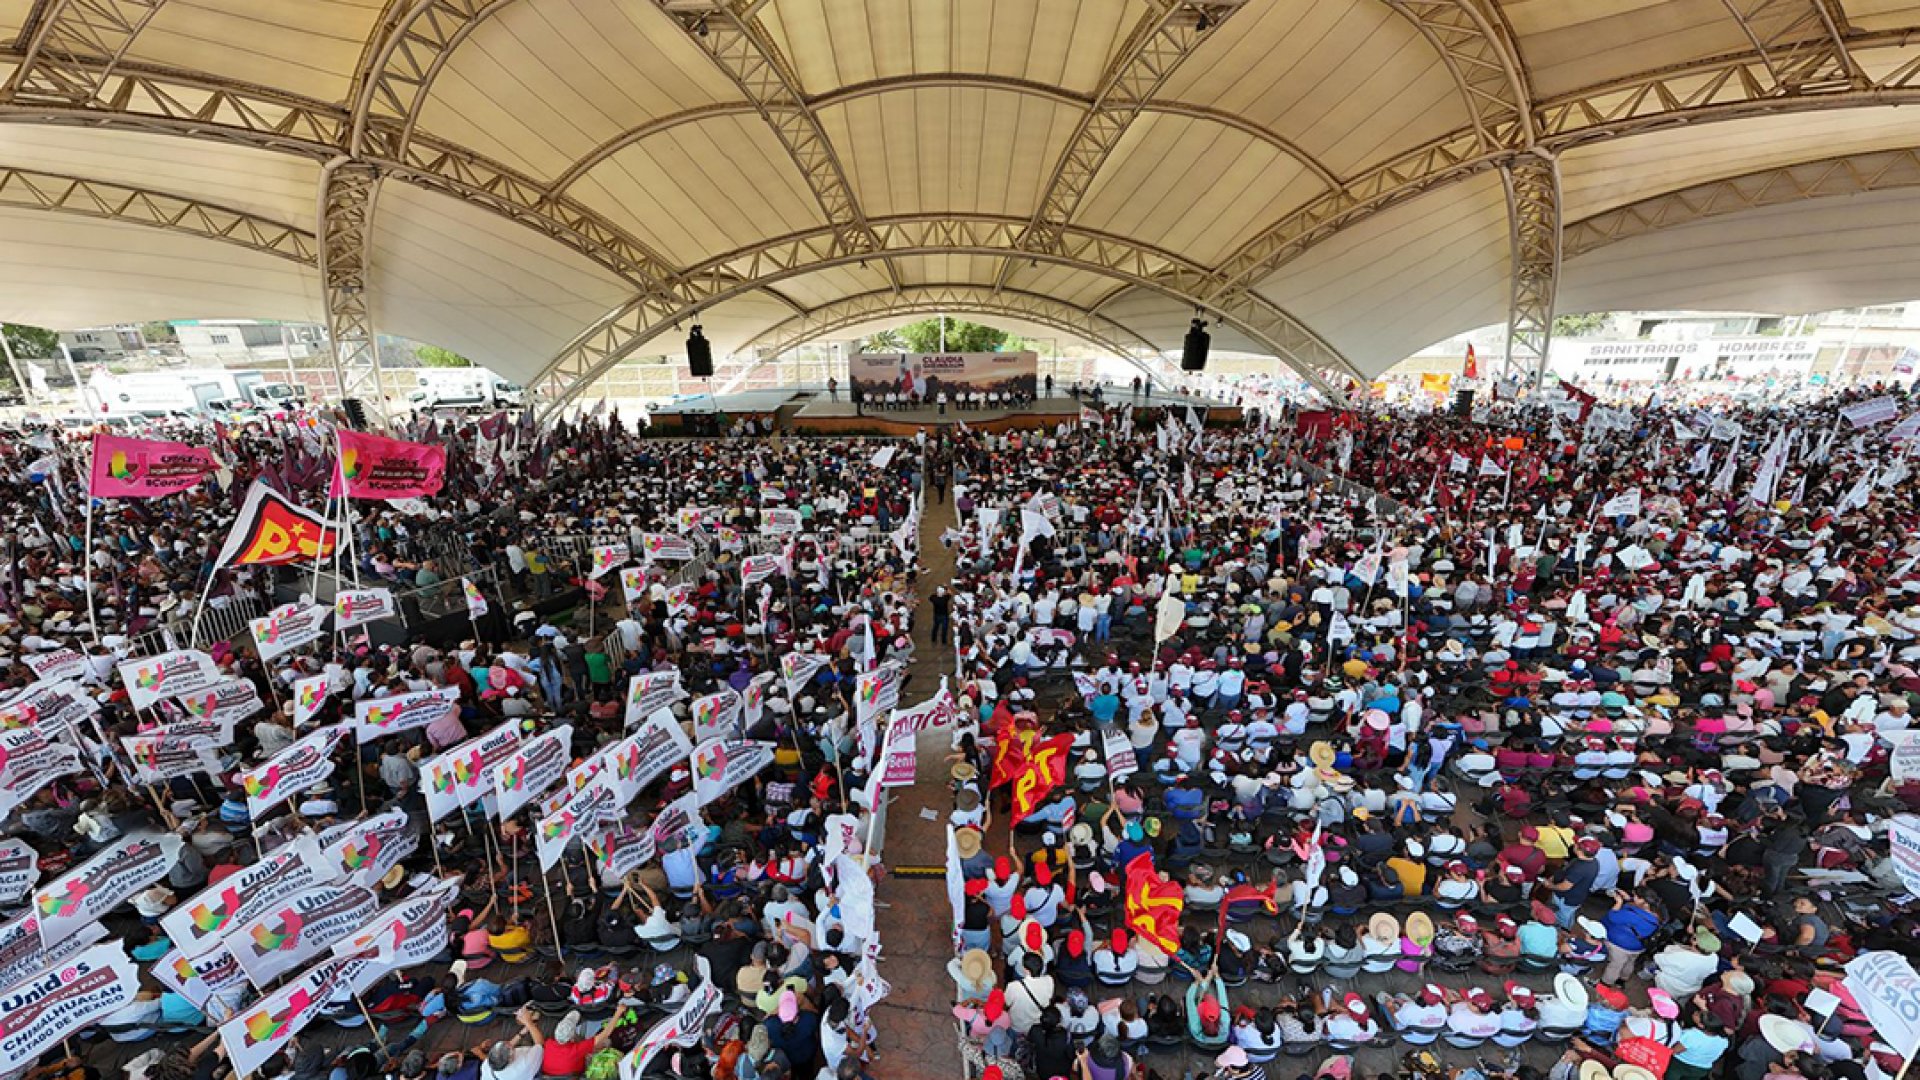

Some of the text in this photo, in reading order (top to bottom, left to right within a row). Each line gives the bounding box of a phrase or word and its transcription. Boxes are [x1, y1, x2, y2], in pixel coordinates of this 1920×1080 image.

[922, 356, 964, 364] CLAUDIA
[1590, 341, 1807, 355] SANITARIOS HOMBRES
[1016, 747, 1057, 813] PT
[2, 962, 92, 1013] Unid@s
[3, 983, 123, 1051] CHIMALHUACAN
[10, 1027, 54, 1061] ESTADO
[55, 1015, 72, 1030] DE
